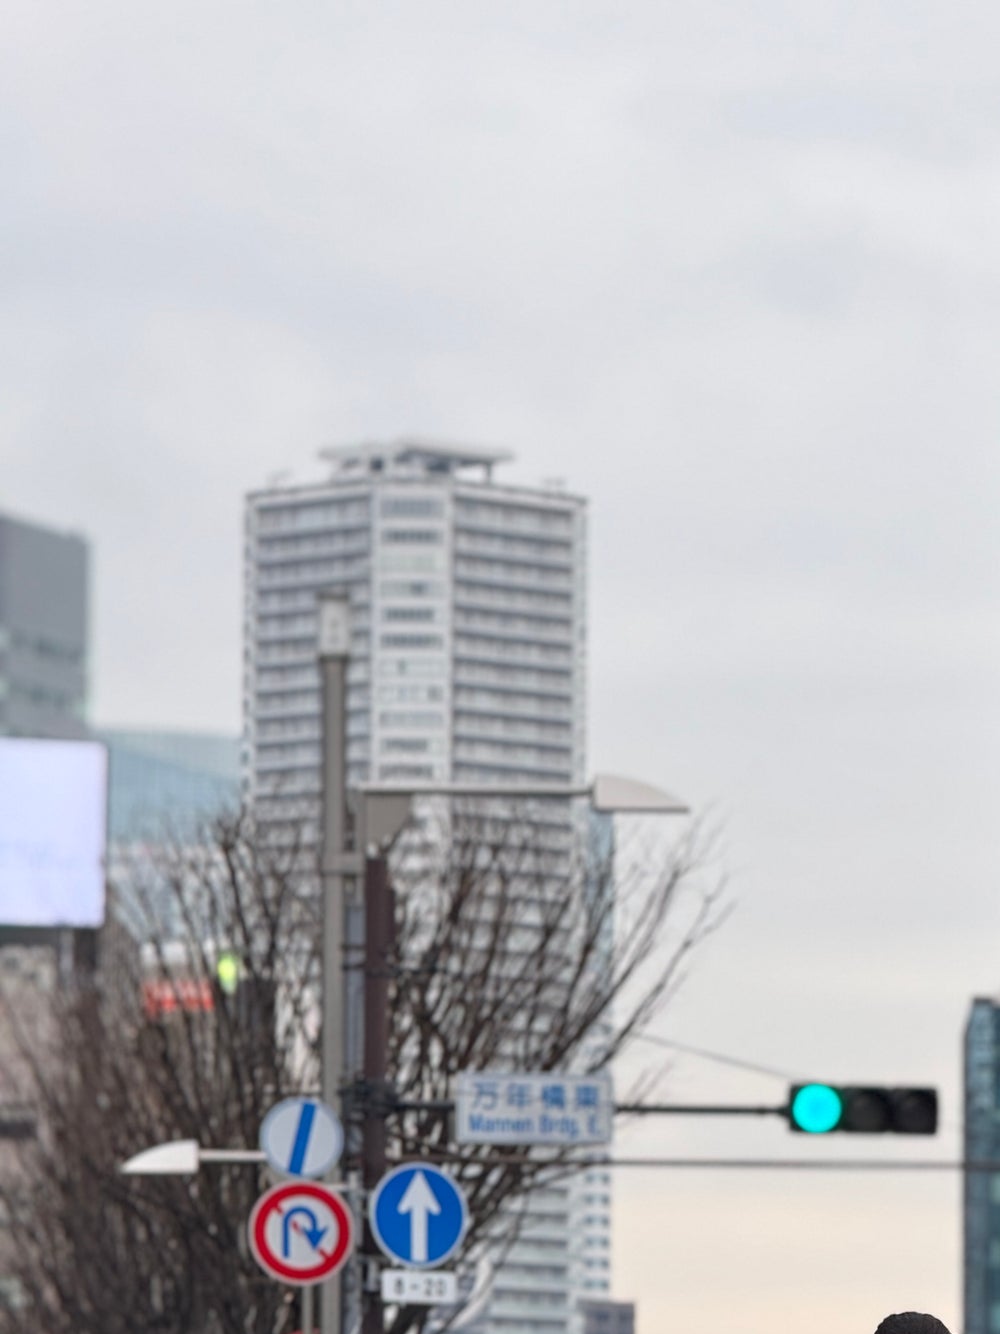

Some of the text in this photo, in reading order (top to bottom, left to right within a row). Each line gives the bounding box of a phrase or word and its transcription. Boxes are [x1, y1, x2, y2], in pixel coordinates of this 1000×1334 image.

[472, 1082, 599, 1110] 万年橋東
[468, 1115, 532, 1133] Mannen
